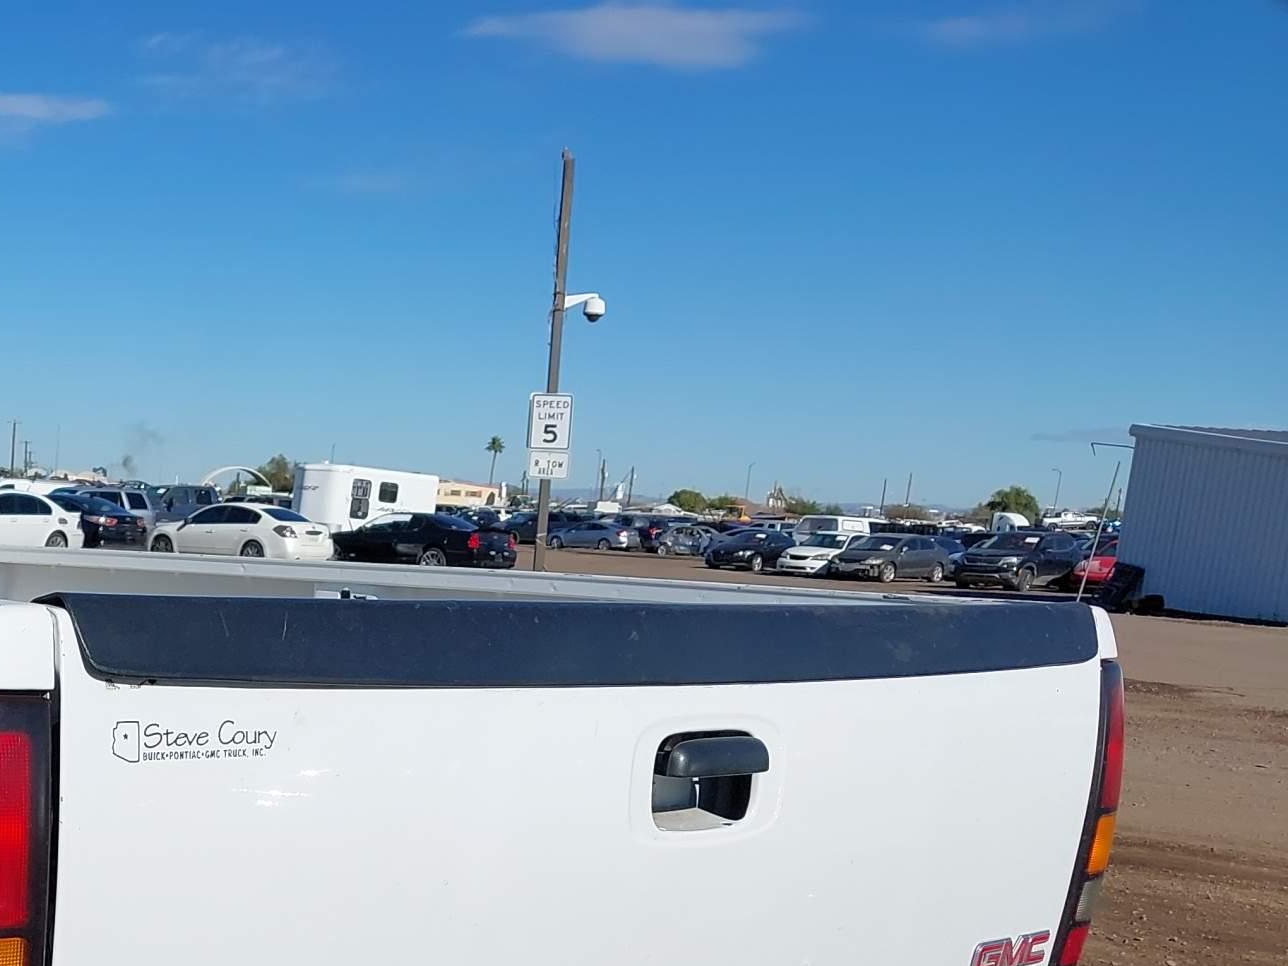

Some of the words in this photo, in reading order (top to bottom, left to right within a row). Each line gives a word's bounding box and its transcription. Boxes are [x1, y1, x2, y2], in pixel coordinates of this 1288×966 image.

[536, 400, 570, 409] SPEED
[538, 412, 565, 421] LIMIT
[542, 424, 558, 443] 5
[143, 723, 210, 749] Steve
[218, 720, 277, 750] Coury
